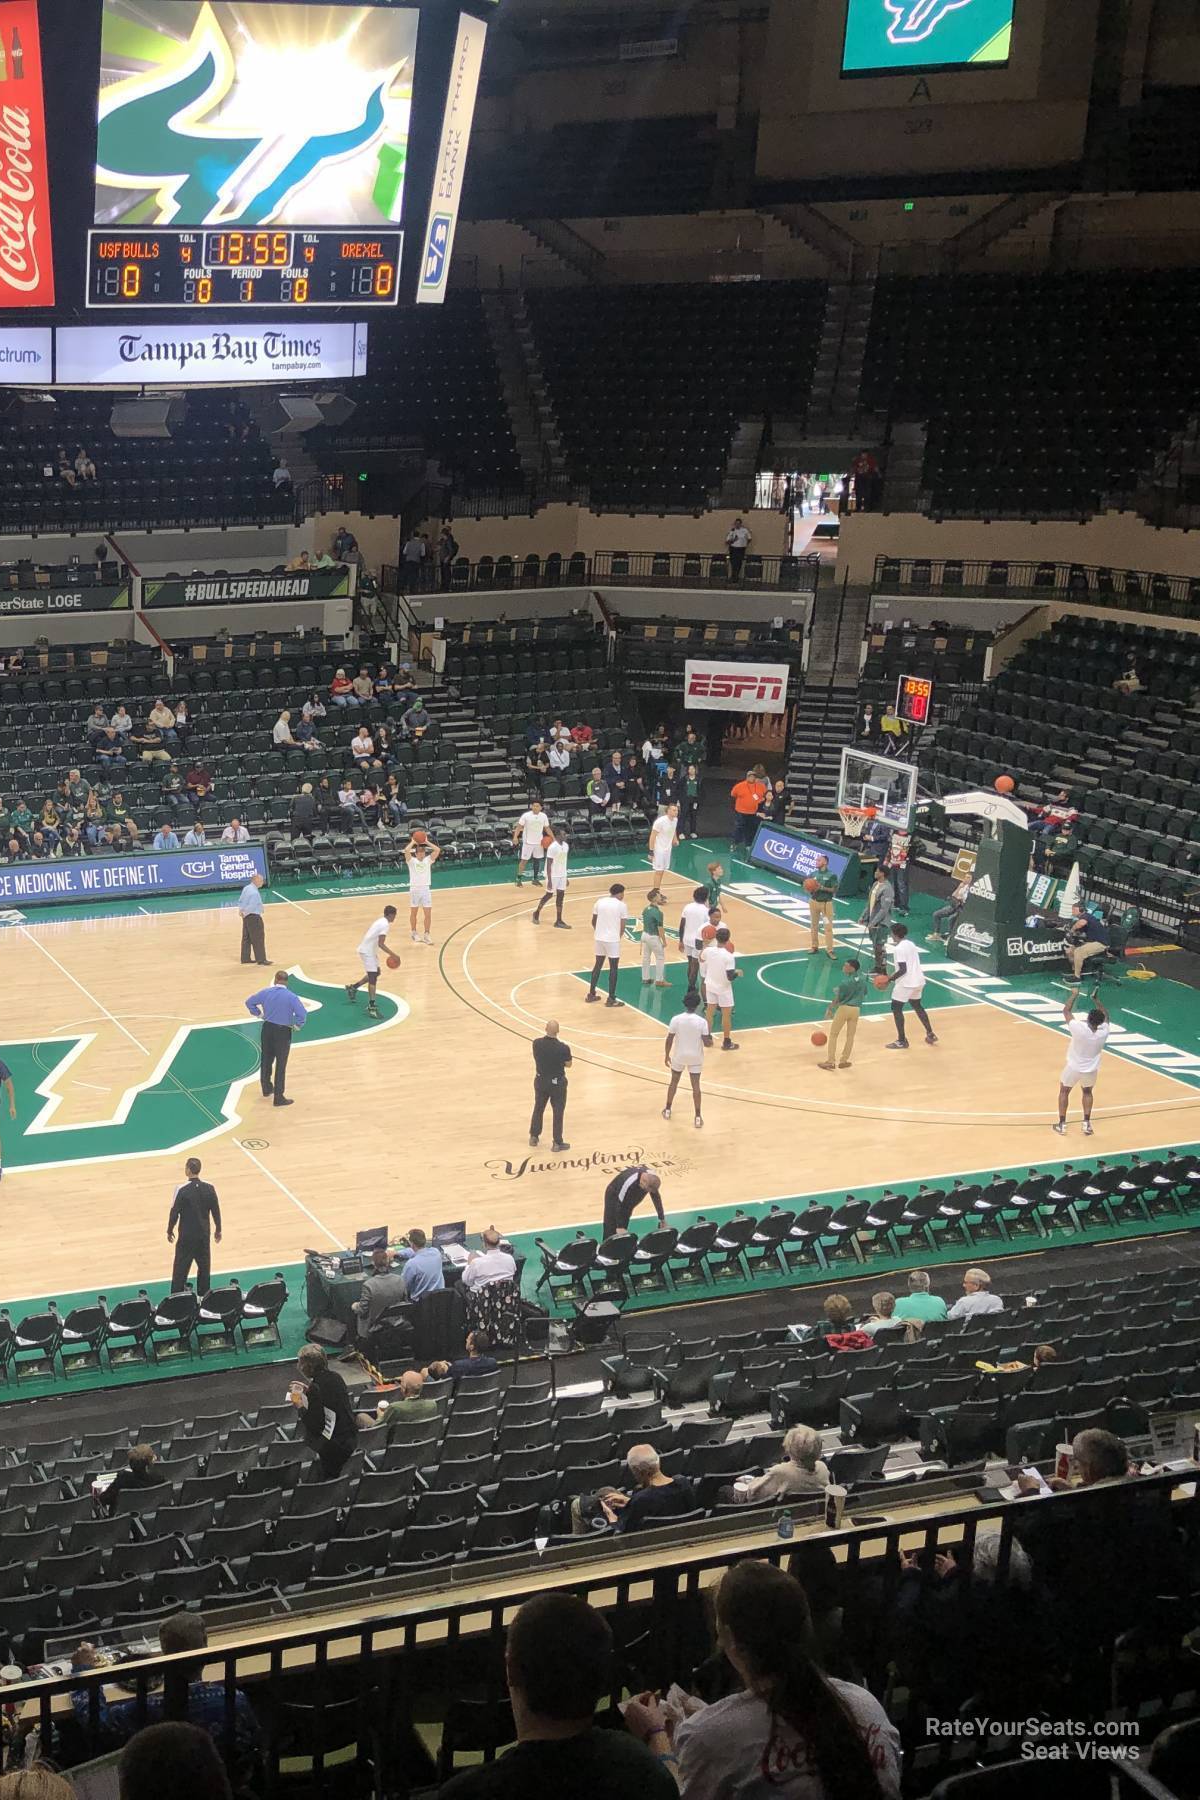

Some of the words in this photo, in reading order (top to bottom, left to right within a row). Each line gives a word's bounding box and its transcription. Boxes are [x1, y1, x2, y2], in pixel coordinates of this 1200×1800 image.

[907, 77, 932, 102] A
[219, 233, 287, 264] 13:55
[341, 243, 384, 258] DREXEL
[123, 265, 140, 296] 0
[183, 268, 212, 279] FOULS
[231, 268, 262, 279] PERIOD
[281, 268, 308, 279] FOULS
[375, 265, 393, 294] 0
[118, 334, 206, 370] Tampa
[212, 332, 258, 365] Bay
[262, 331, 321, 358] Times
[271, 362, 322, 371] tampabay.com
[184, 579, 309, 601] #BULLSPEEDAHEAD
[48, 594, 82, 608] LOGE
[688, 673, 783, 700] ESPN
[905, 680, 929, 697] 13:55
[763, 838, 794, 860] TGH
[219, 853, 250, 863] Tampa
[220, 860, 255, 873] General
[182, 860, 215, 876] TGH
[15, 871, 77, 895] MEDICINE.
[81, 869, 101, 889] WE
[104, 865, 145, 888] DEFINE
[148, 864, 163, 884] IT.
[969, 886, 996, 901] adidas
[484, 1145, 646, 1181] Yuengling
